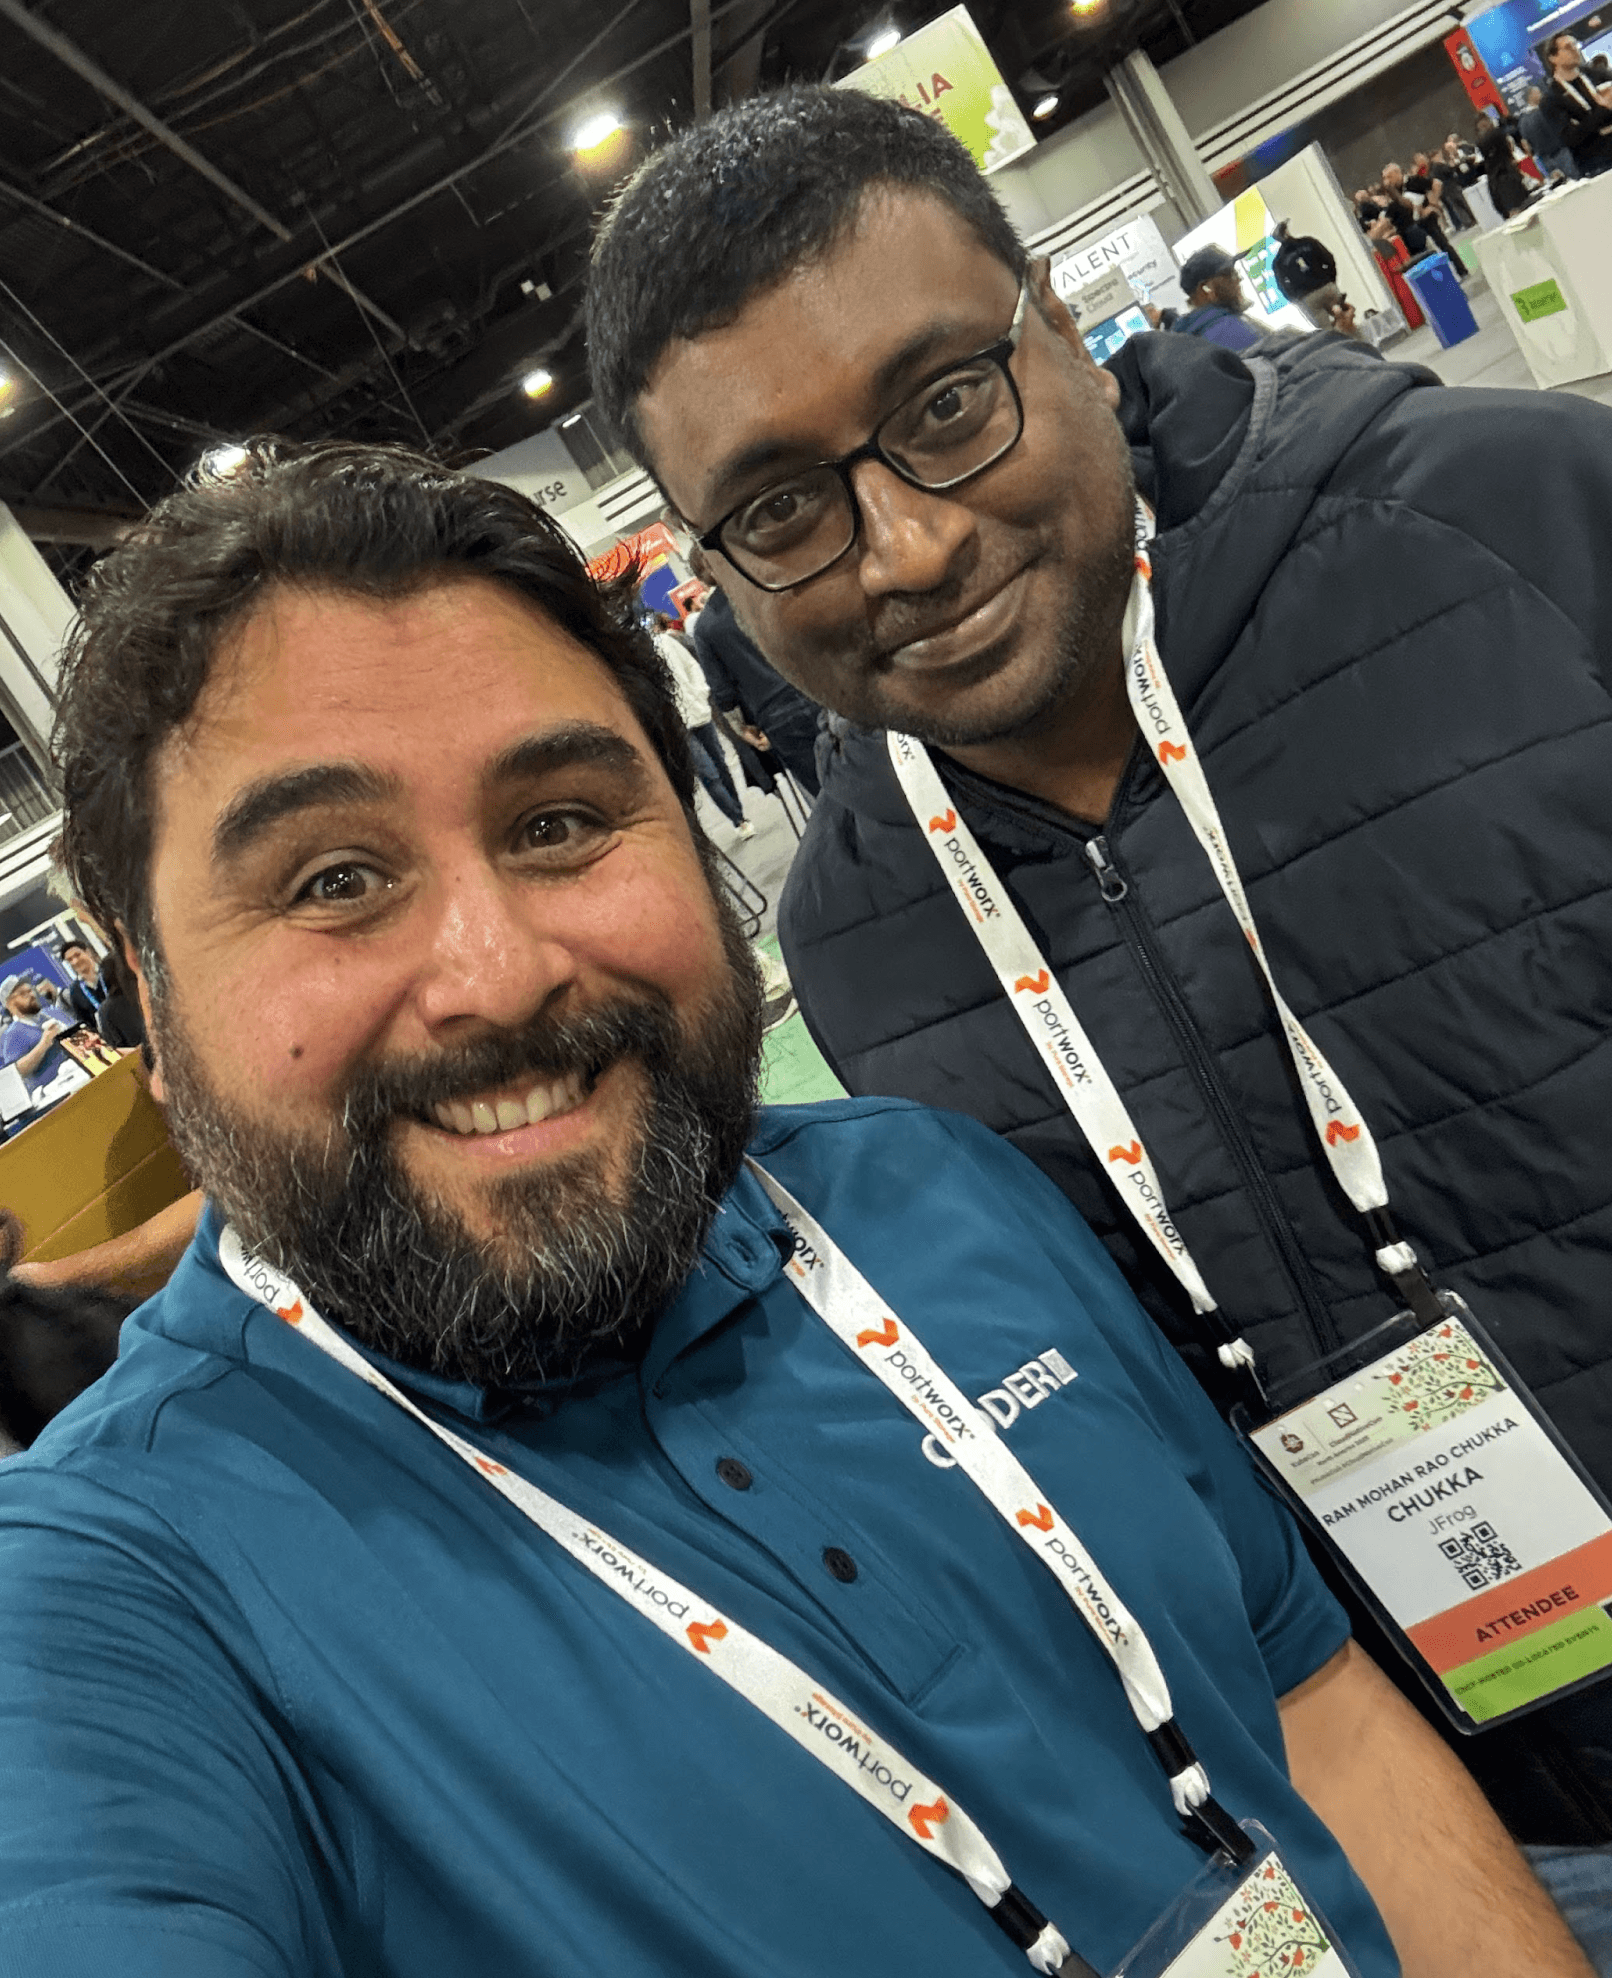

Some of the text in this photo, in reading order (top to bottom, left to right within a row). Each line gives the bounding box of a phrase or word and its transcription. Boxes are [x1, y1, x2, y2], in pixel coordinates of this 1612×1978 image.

[1053, 232, 1130, 289] ALENT
[1127, 259, 1157, 280] ecurity
[944, 837, 998, 918] portworx
[1033, 998, 1087, 1084] portworx
[1128, 1170, 1187, 1257] portworx
[885, 1349, 971, 1439] portworx
[921, 1361, 1062, 1468] CDER
[1321, 1502, 1358, 1526] RAM
[1355, 1472, 1415, 1509] MOHAN
[1413, 1453, 1449, 1478] RAO
[1450, 1418, 1519, 1458] CHUKKA
[1387, 1467, 1484, 1522] CHUKKA
[1427, 1505, 1477, 1535] JFrog
[579, 1531, 689, 1619] portworx
[1045, 1537, 1126, 1646] portworx
[1476, 1585, 1580, 1643] ATTENDEE
[802, 1702, 913, 1801] portworx
